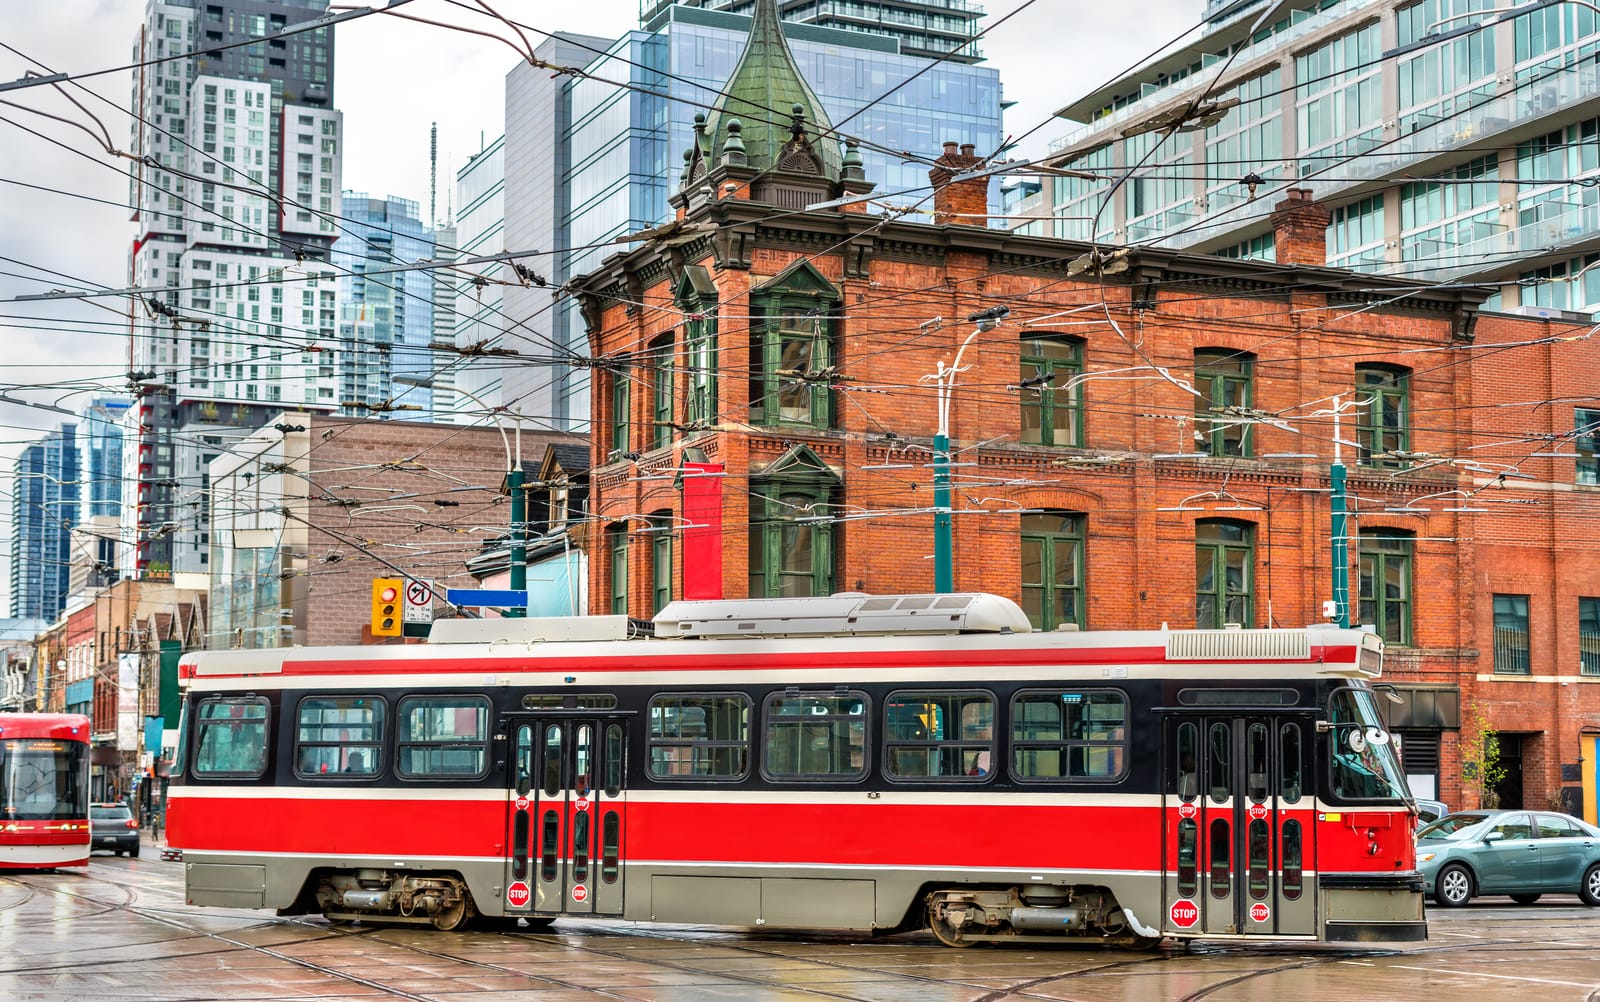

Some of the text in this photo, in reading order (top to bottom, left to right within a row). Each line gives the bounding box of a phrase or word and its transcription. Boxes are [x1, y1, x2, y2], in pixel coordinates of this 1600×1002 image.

[510, 890, 527, 899] STOP
[1173, 909, 1196, 919] STOP
[1251, 909, 1268, 917] STOP
